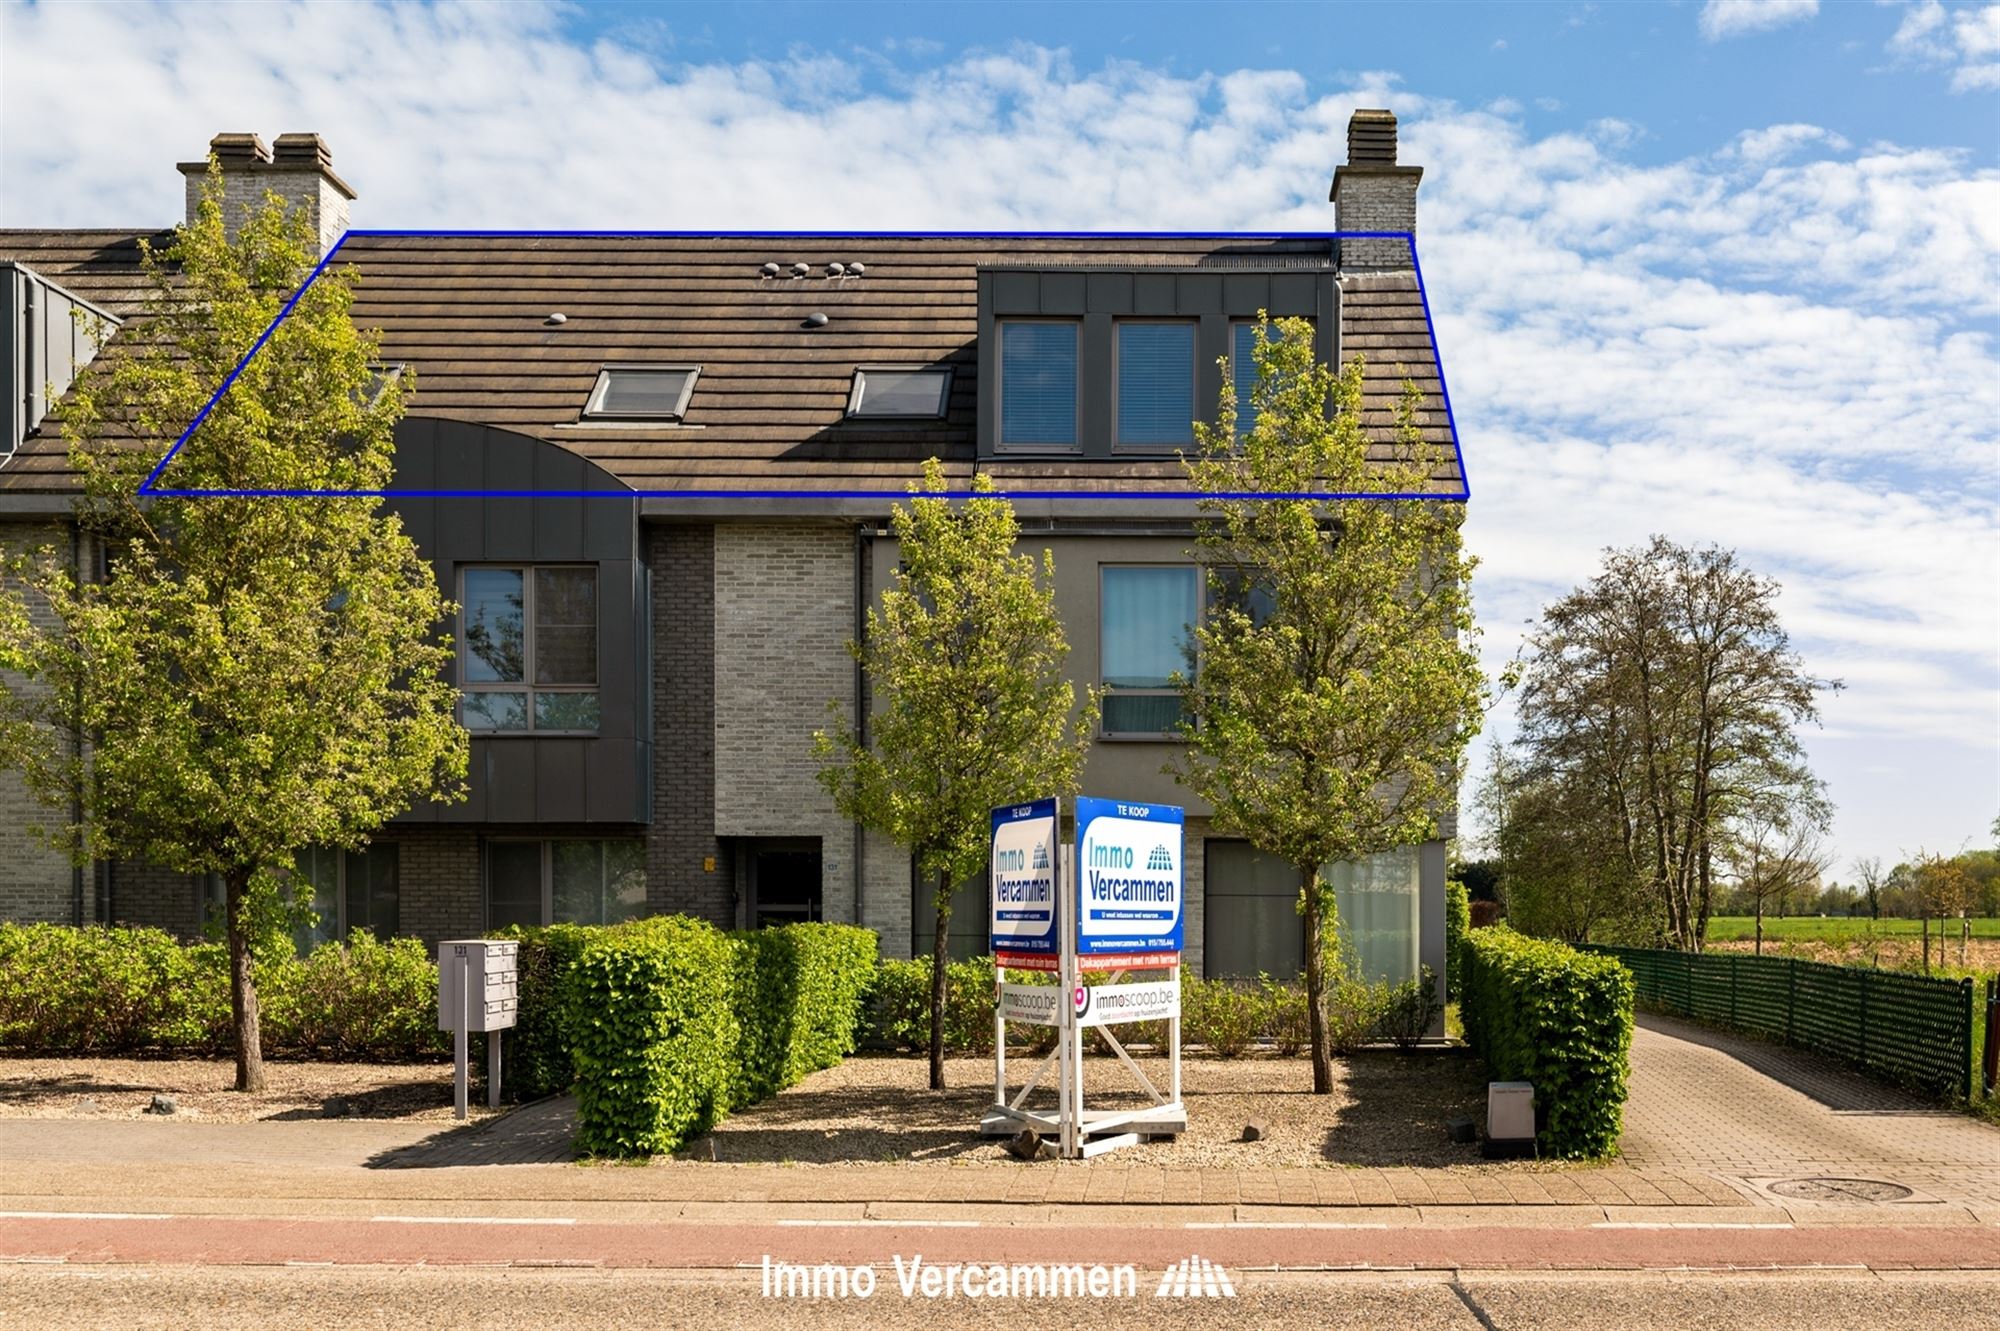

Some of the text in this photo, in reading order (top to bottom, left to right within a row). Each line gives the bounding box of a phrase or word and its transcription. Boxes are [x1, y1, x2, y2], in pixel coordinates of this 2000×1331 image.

[1117, 804, 1149, 817] TE KOOP
[996, 844, 1024, 872] Immo
[1089, 836, 1133, 869] Immo
[996, 874, 1050, 902] Vercammen
[1089, 870, 1174, 902] Vercammen
[1096, 987, 1174, 1009] immoscoop.be
